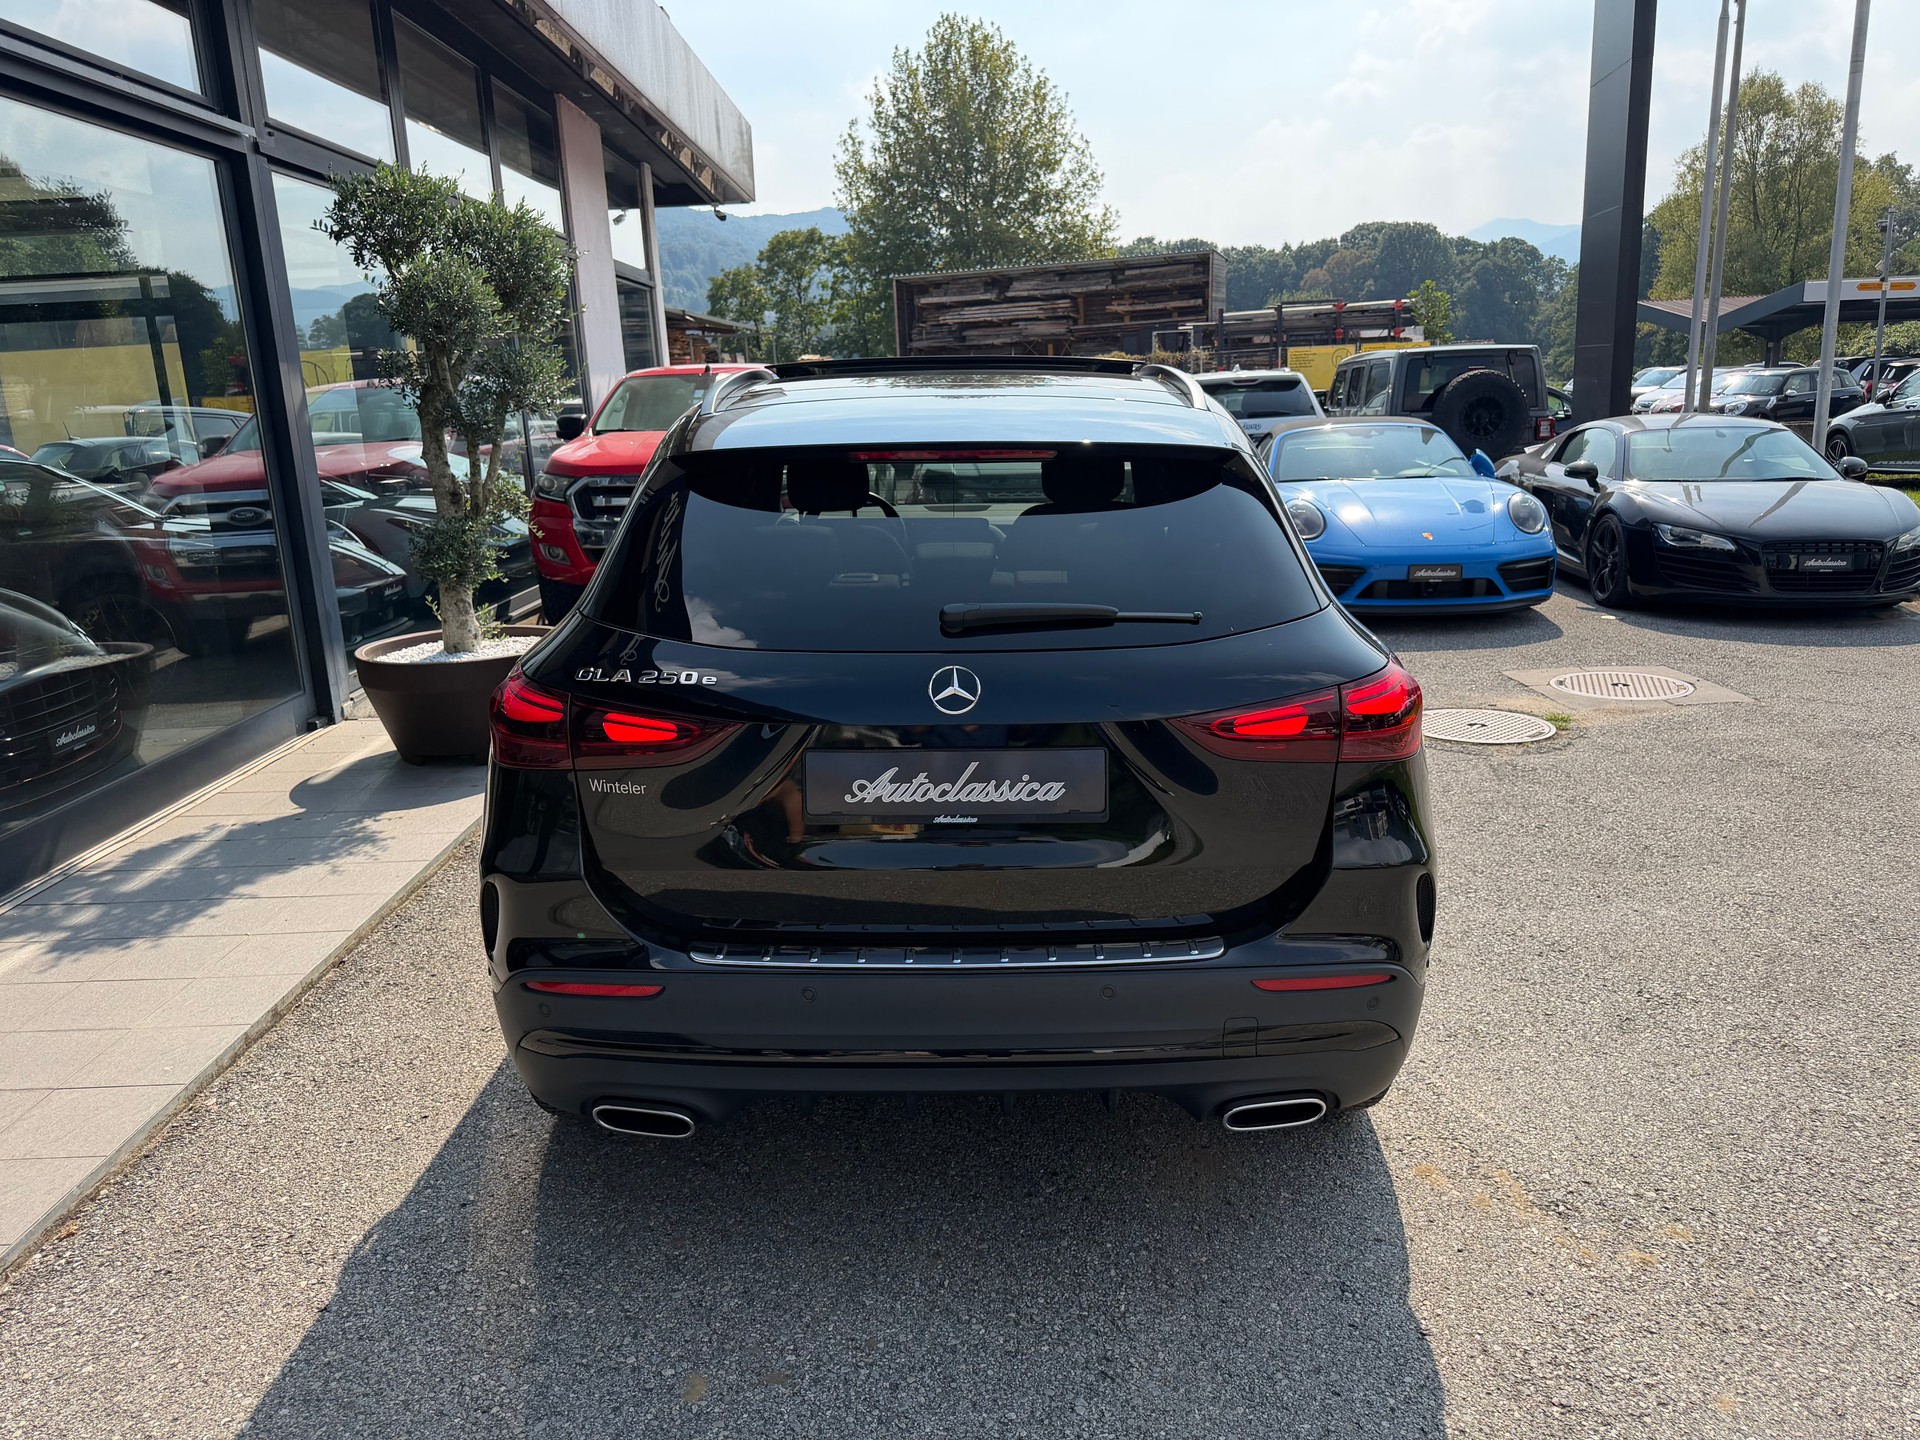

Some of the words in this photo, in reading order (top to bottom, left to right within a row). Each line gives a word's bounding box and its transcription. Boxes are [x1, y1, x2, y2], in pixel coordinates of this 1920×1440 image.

[574, 667, 632, 683] GLA
[588, 778, 647, 795] Winteler
[845, 761, 1067, 804] Autoclassica
[934, 814, 978, 823] Autoclassica
